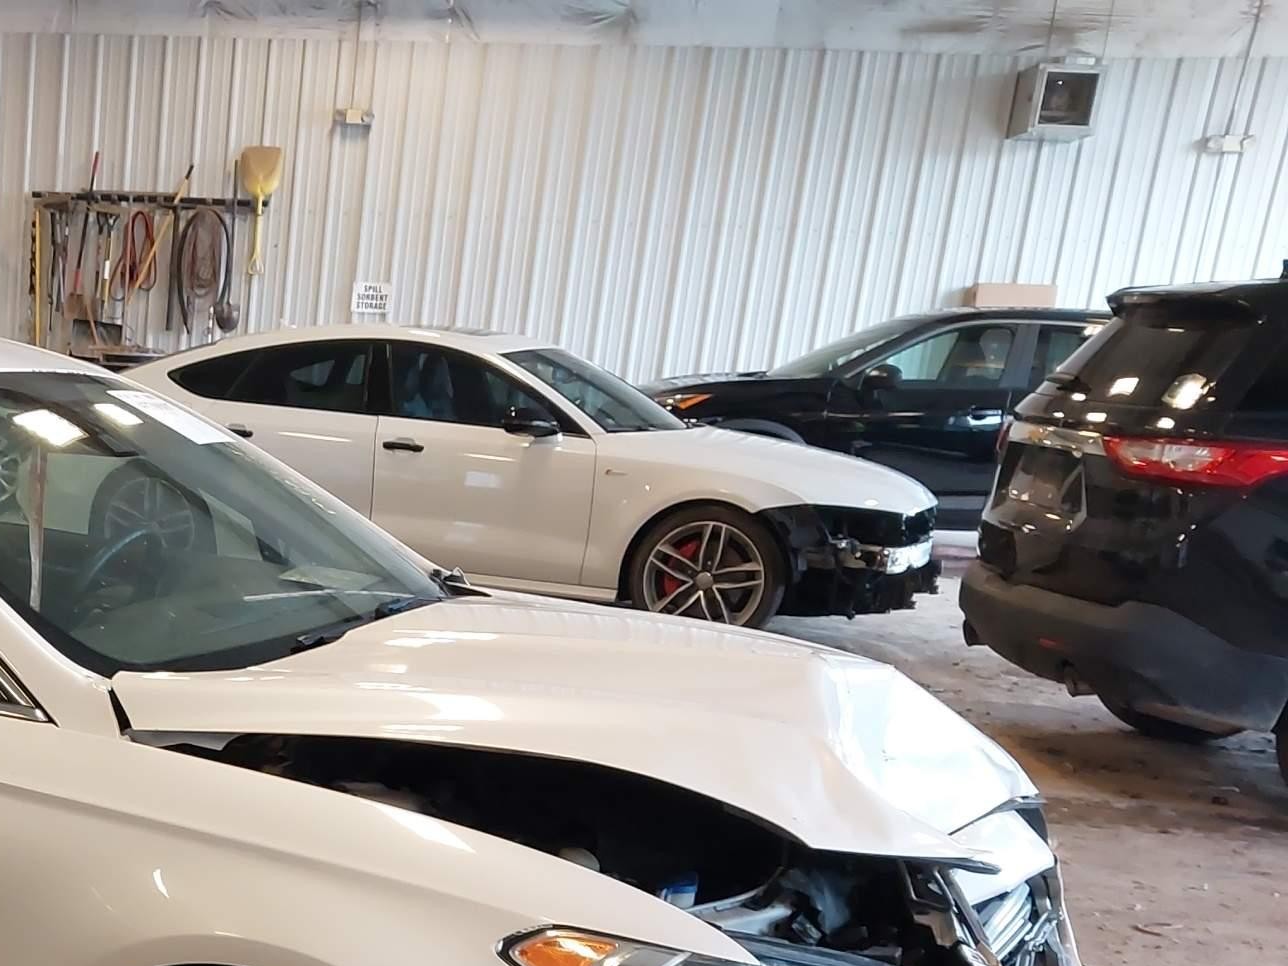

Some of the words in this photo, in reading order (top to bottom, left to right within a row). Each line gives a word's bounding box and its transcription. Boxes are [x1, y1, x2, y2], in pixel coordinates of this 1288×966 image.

[364, 285, 383, 293] SPILL
[357, 293, 388, 302] SORBENT
[356, 301, 387, 311] STORAGE
